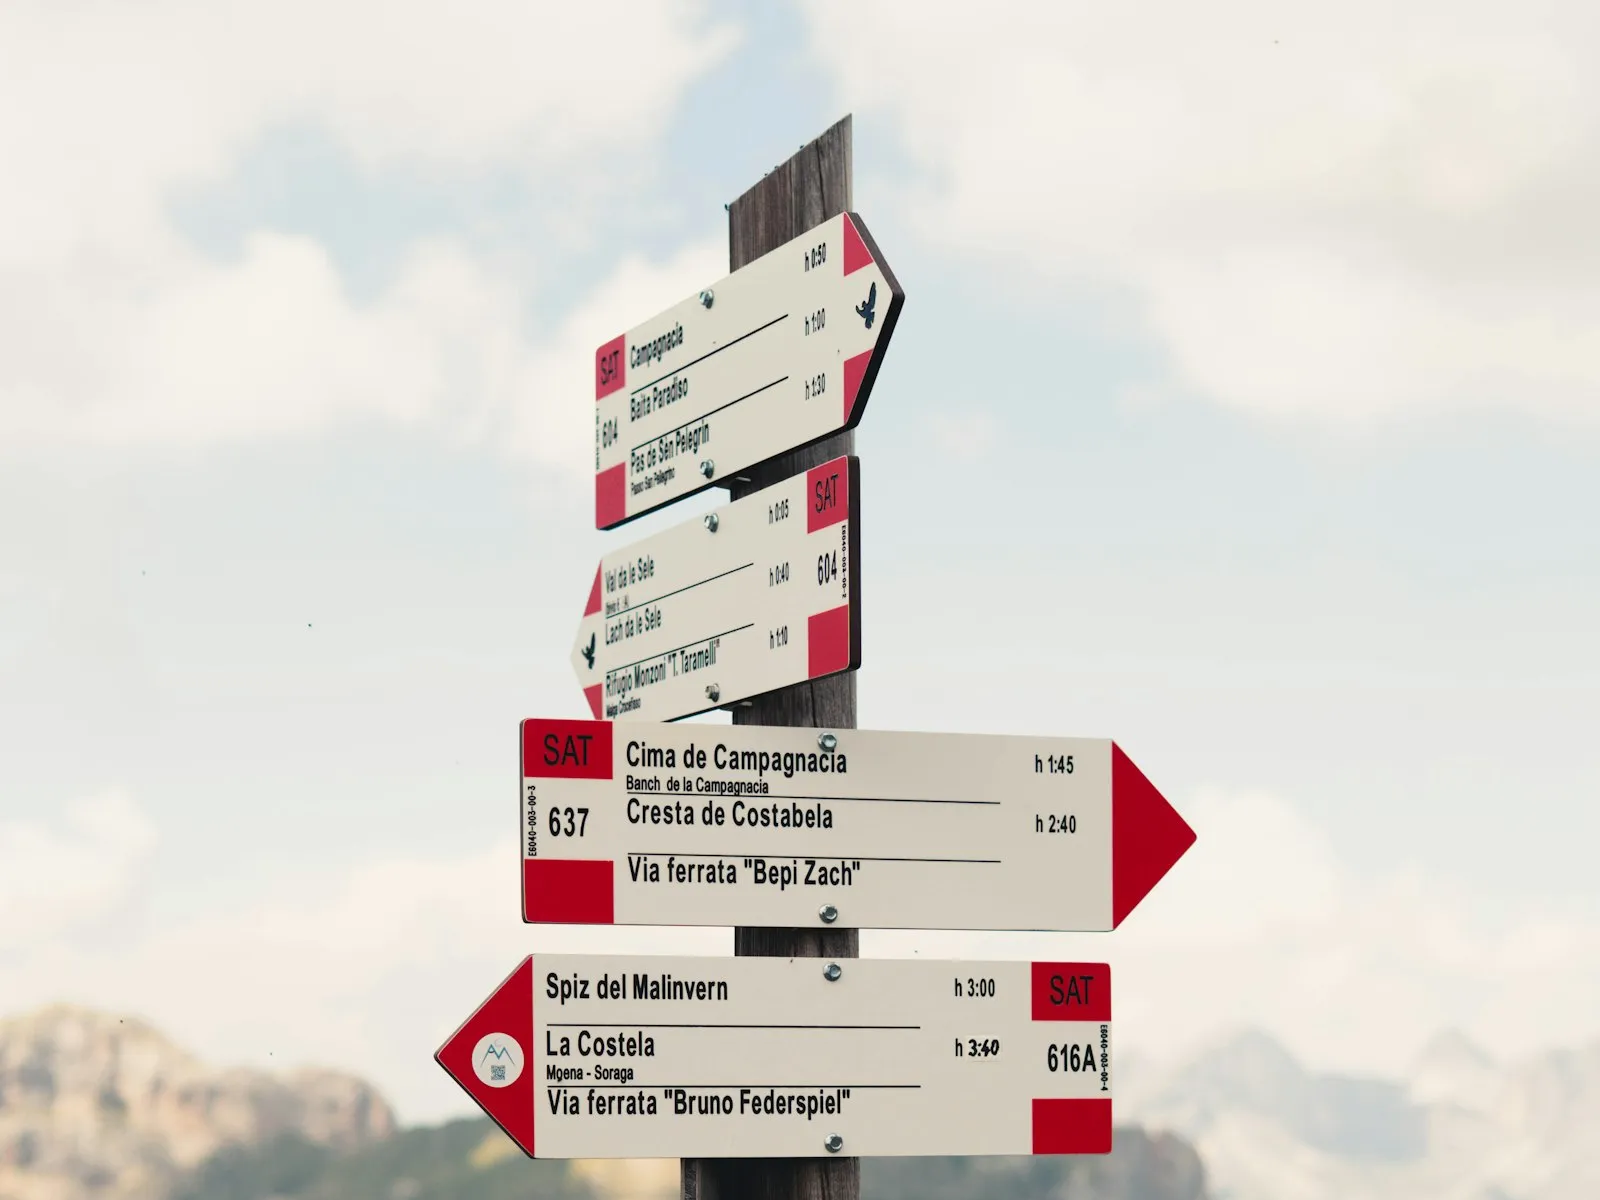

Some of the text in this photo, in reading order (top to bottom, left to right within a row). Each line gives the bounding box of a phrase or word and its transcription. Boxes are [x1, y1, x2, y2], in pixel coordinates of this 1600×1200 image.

[805, 242, 826, 272] h 0:50
[805, 308, 825, 336] h 1:00
[631, 322, 683, 369] Campagnacia
[601, 350, 619, 385] SAT
[631, 376, 687, 422] Baita Paradiso
[805, 373, 825, 400] h 1:30
[603, 417, 618, 448] 604
[631, 452, 644, 476] Pas
[647, 445, 656, 467] de
[816, 474, 838, 513] SAT
[769, 499, 789, 524] h 0:05
[606, 554, 654, 593] Val da le Sele
[769, 562, 789, 587] h 0:40
[818, 550, 837, 585] 604
[606, 618, 622, 645] Lach
[625, 615, 633, 638] da
[636, 611, 642, 635] le
[645, 605, 661, 632] Sele
[770, 626, 788, 649] h 1:10
[606, 669, 632, 699] Rifugio
[635, 657, 666, 689] Monzoni
[681, 639, 720, 674] Taramelli"
[543, 733, 593, 767] SAT
[626, 740, 848, 777] Cima de Campagnacia
[1035, 754, 1074, 774] h 1:45
[626, 775, 769, 796] Banch de la Campagnacia
[527, 785, 537, 857] E6040-003-00-3
[548, 806, 589, 837] 637
[627, 797, 833, 829] Cresta de Costabela
[1035, 814, 1077, 834] h 2:40
[627, 856, 862, 891] Via ferrata "Bepi Zach"
[546, 972, 728, 1006] Spiz del Malinvern
[954, 977, 995, 998] h 3:00
[1050, 975, 1094, 1005] SAT
[546, 1030, 655, 1057] La Costela
[955, 1038, 1000, 1058] h 3:40
[1047, 1043, 1097, 1073] 616A
[1100, 1024, 1109, 1091] E6040-003-00-4
[594, 1065, 633, 1084] Soraga
[547, 1088, 851, 1121] Via ferrata "Bruno Federspiel"
